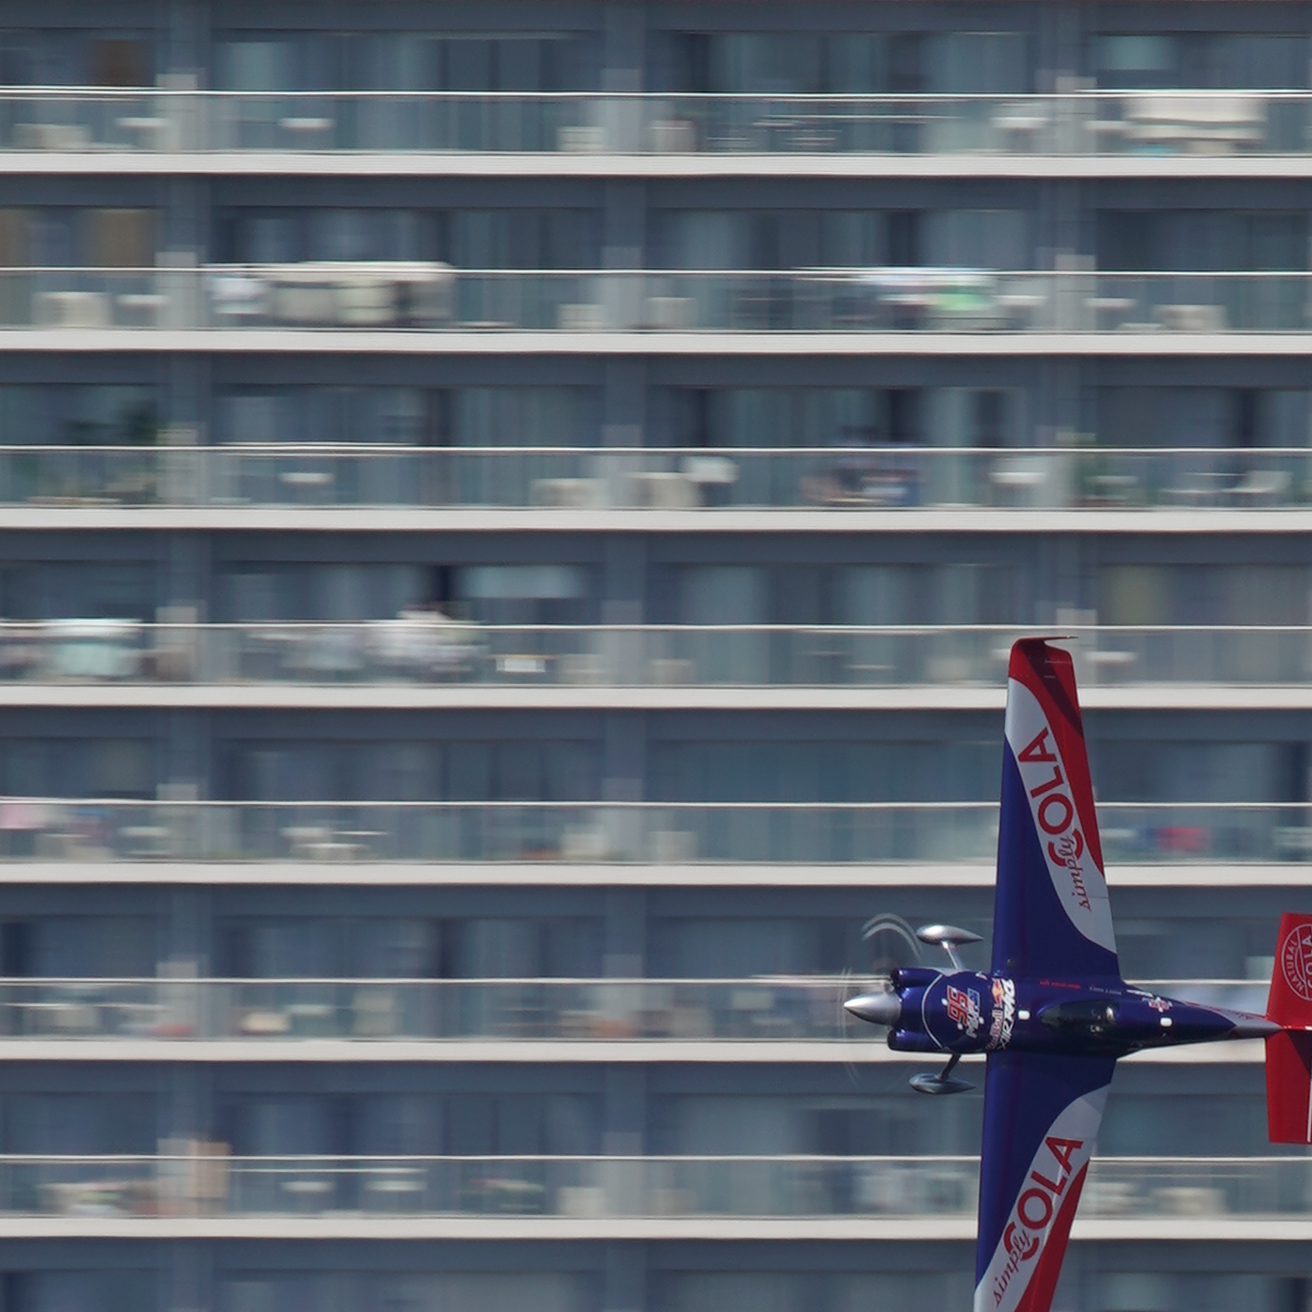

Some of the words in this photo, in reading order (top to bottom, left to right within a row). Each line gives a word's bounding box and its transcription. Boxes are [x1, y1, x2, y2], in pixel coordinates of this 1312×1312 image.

[1018, 727, 1084, 867] COLA
[1058, 837, 1092, 912] simply
[1286, 939, 1305, 992] NATURAL
[947, 985, 969, 1026] 95
[1004, 1136, 1084, 1262] COLA
[993, 1229, 1031, 1308] simply
